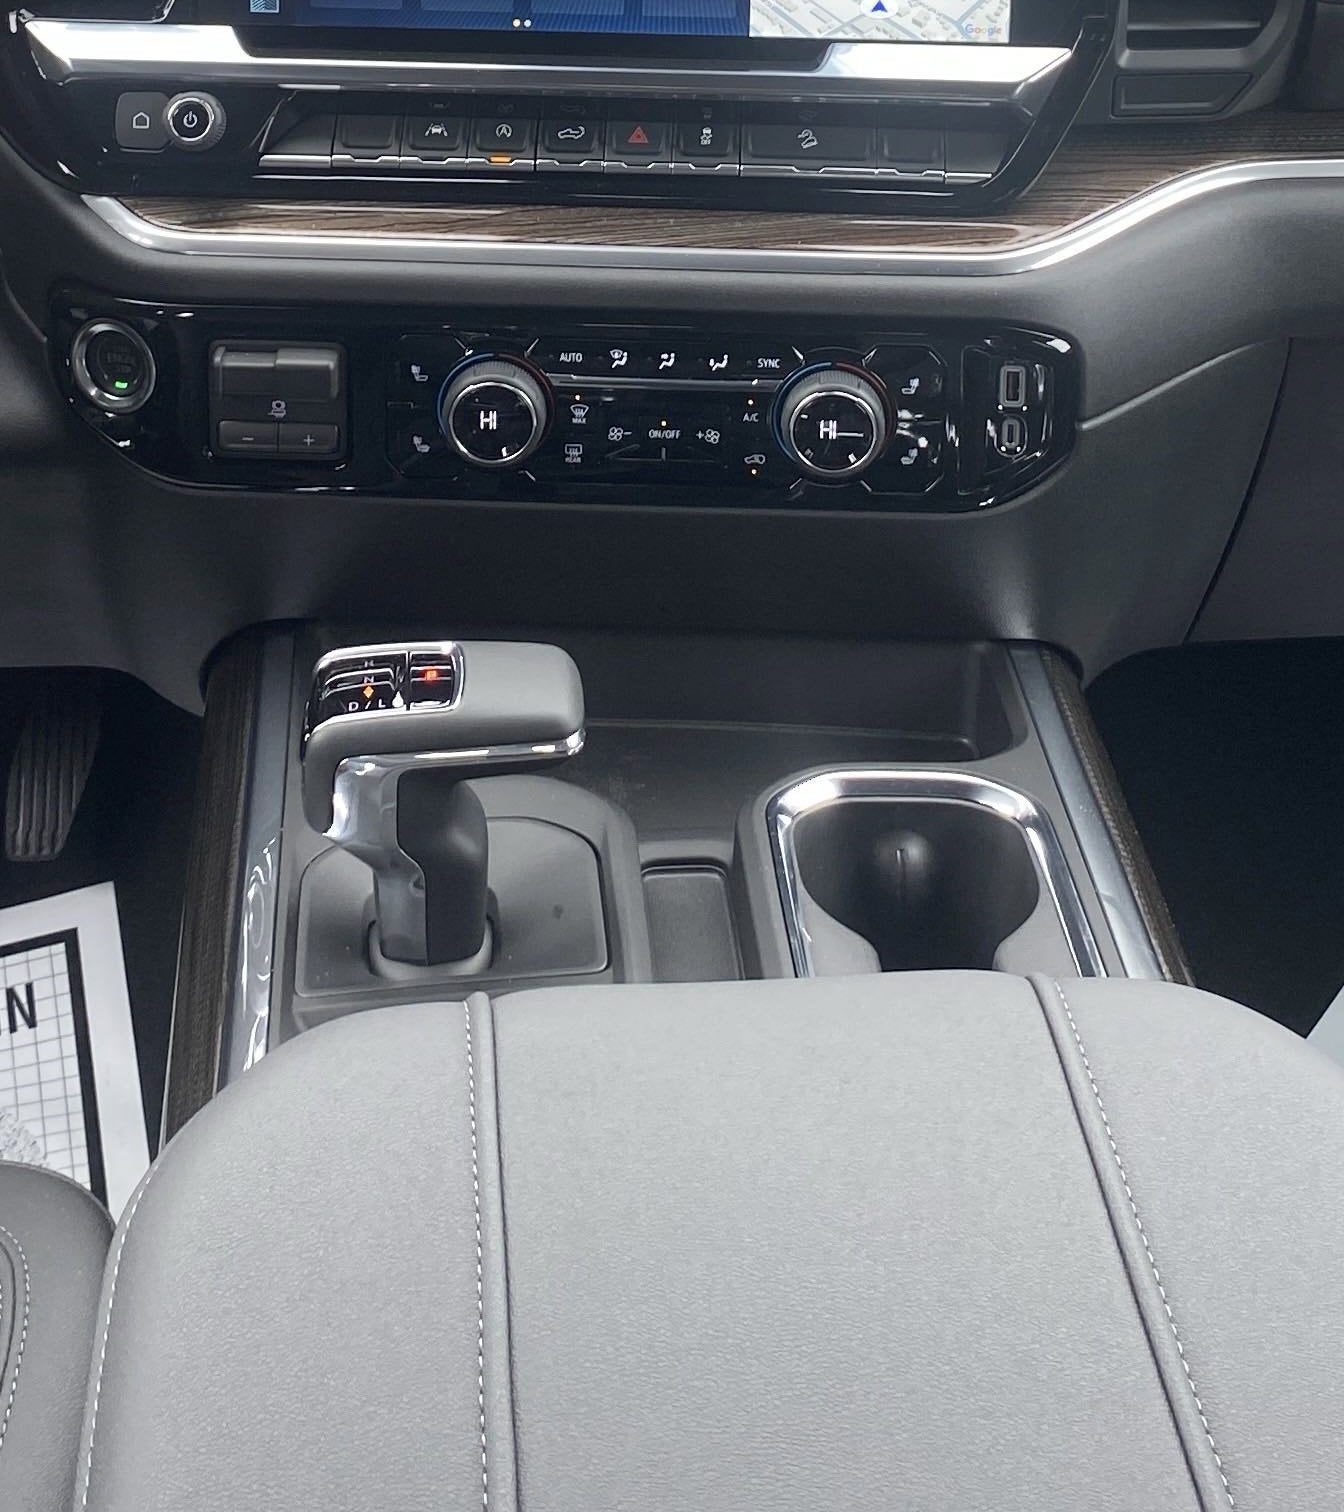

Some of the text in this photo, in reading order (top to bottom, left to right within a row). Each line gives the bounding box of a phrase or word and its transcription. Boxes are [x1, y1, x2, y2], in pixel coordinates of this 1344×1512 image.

[964, 23, 1002, 37] Google
[560, 352, 583, 363] AUTO
[757, 358, 781, 369] SYNC
[479, 410, 497, 430] HI
[743, 412, 759, 422] A/C
[648, 429, 680, 439] ON/OFF
[819, 419, 837, 440] HI
[348, 702, 360, 712] D
